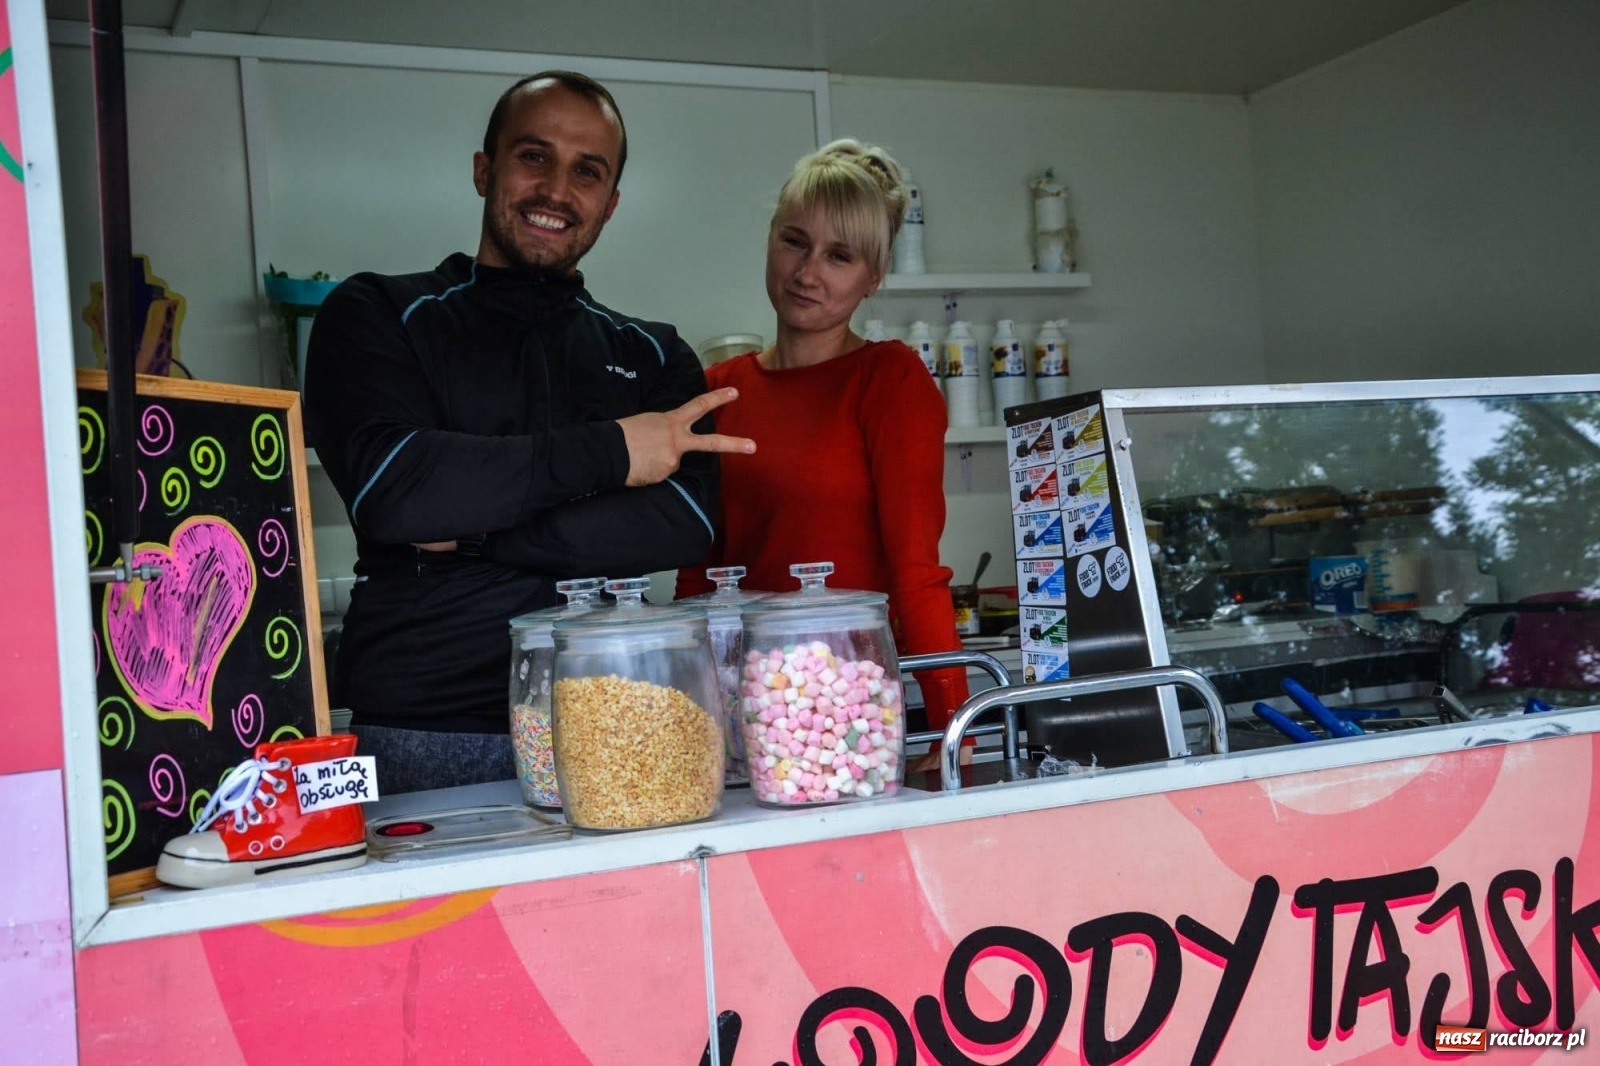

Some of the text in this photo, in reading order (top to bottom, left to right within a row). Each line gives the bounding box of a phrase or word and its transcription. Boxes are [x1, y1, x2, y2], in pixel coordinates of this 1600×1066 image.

[1057, 416, 1069, 431] ZLOT
[1012, 425, 1023, 439] ZLOT
[1015, 470, 1027, 483] ZLOT
[1062, 463, 1074, 477] ZLOT
[1019, 514, 1031, 527] ZLOT
[1068, 508, 1080, 523] ZLOT
[1023, 562, 1035, 573] ZLOT
[1320, 563, 1362, 588] OREO
[1025, 608, 1037, 620] ZLOT
[1027, 653, 1039, 665] ZLOT
[698, 874, 1278, 1066] OODY
